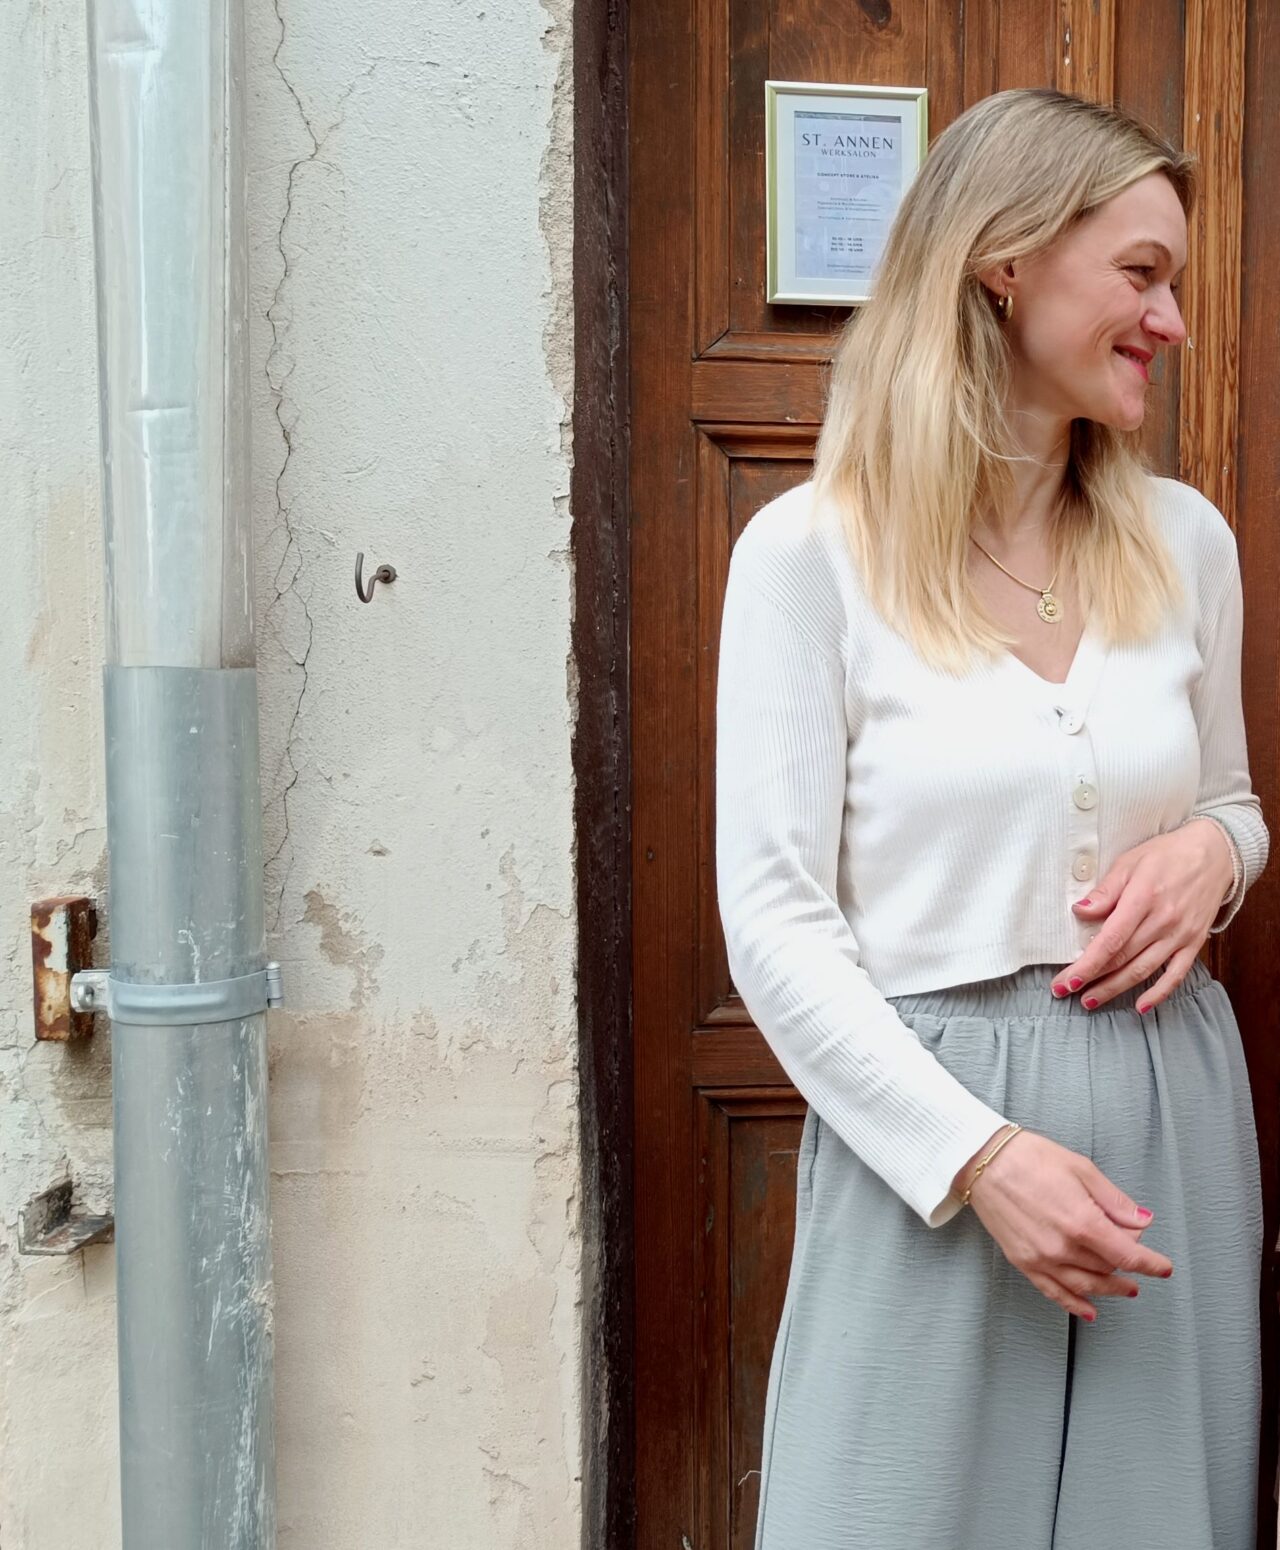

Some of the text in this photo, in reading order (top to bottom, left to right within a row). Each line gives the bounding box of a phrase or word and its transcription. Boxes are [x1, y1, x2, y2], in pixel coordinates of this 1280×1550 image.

[801, 133, 893, 150] ST. ANNEN
[821, 148, 877, 158] WERKSALON
